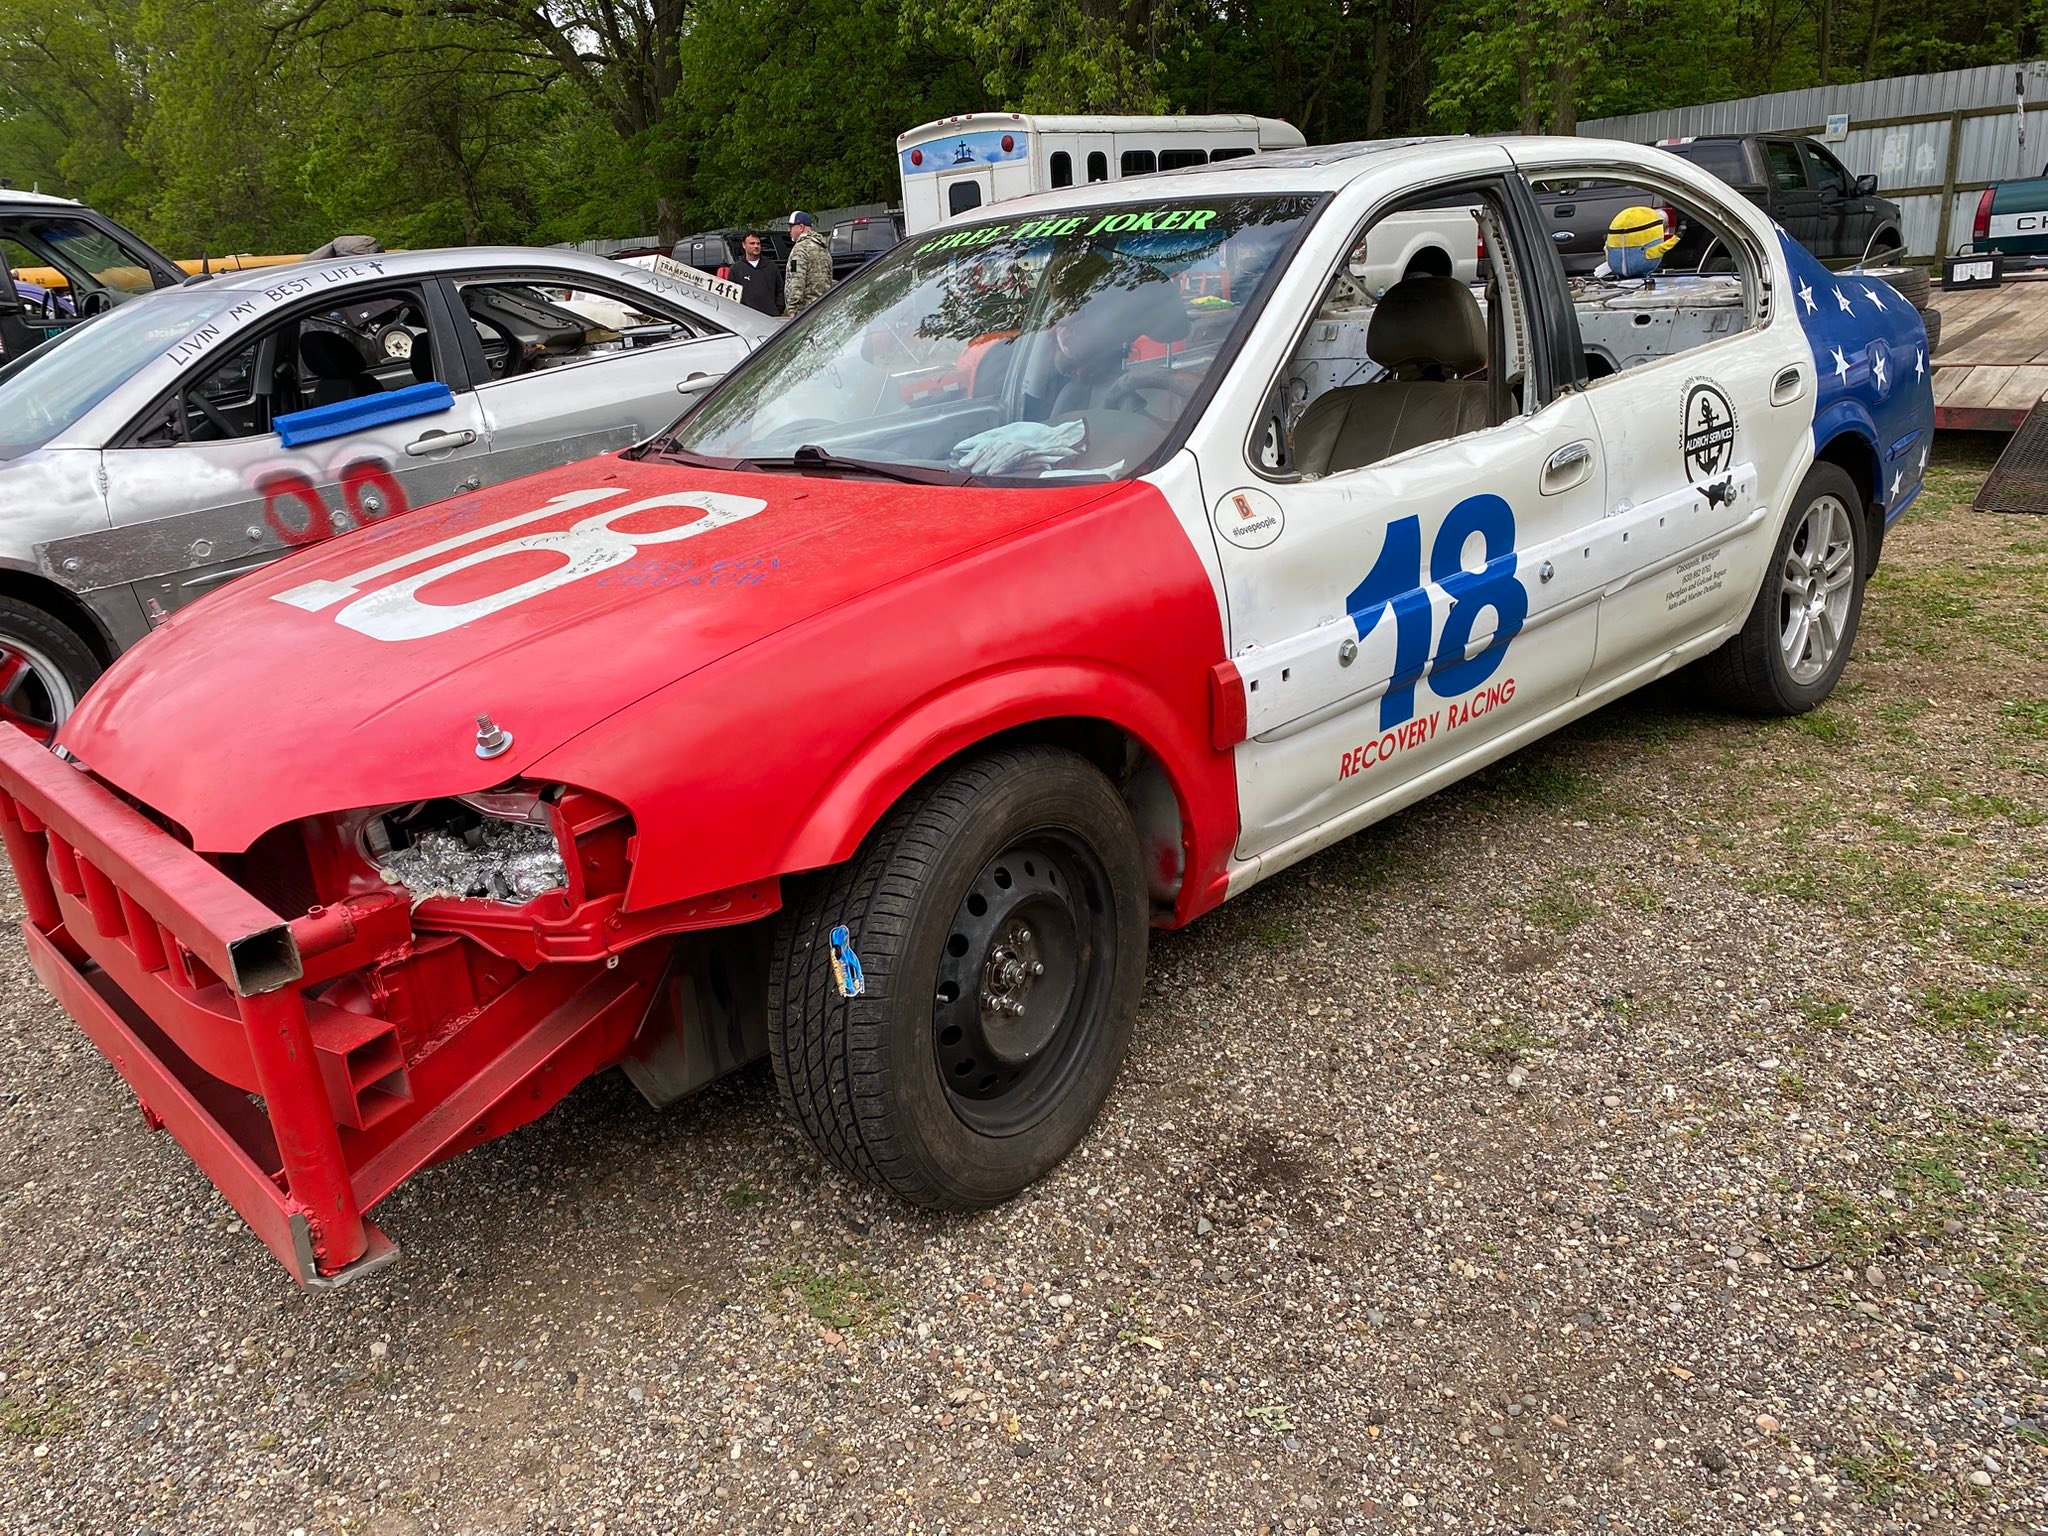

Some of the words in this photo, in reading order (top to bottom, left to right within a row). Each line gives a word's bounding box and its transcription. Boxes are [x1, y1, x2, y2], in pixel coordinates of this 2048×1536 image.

[913, 224, 1011, 257] #FREE
[1010, 216, 1090, 240] THE
[1089, 210, 1217, 236] JOKER
[659, 261, 704, 284] TRAMPOLINE
[706, 278, 739, 301] 14ft
[166, 324, 221, 366] LIVIN
[228, 300, 257, 322] MY
[265, 276, 313, 302] BEST
[319, 264, 365, 283] LIFE
[1680, 375, 1696, 395] highly
[1685, 434, 1709, 452] ALDRICH
[1709, 426, 1733, 445] SERVICES
[1232, 516, 1277, 538] #lovepeople
[268, 486, 769, 642] 18
[1345, 493, 1529, 734] 18
[1338, 709, 1441, 782] RECOVERY
[1446, 677, 1517, 732] RACING
